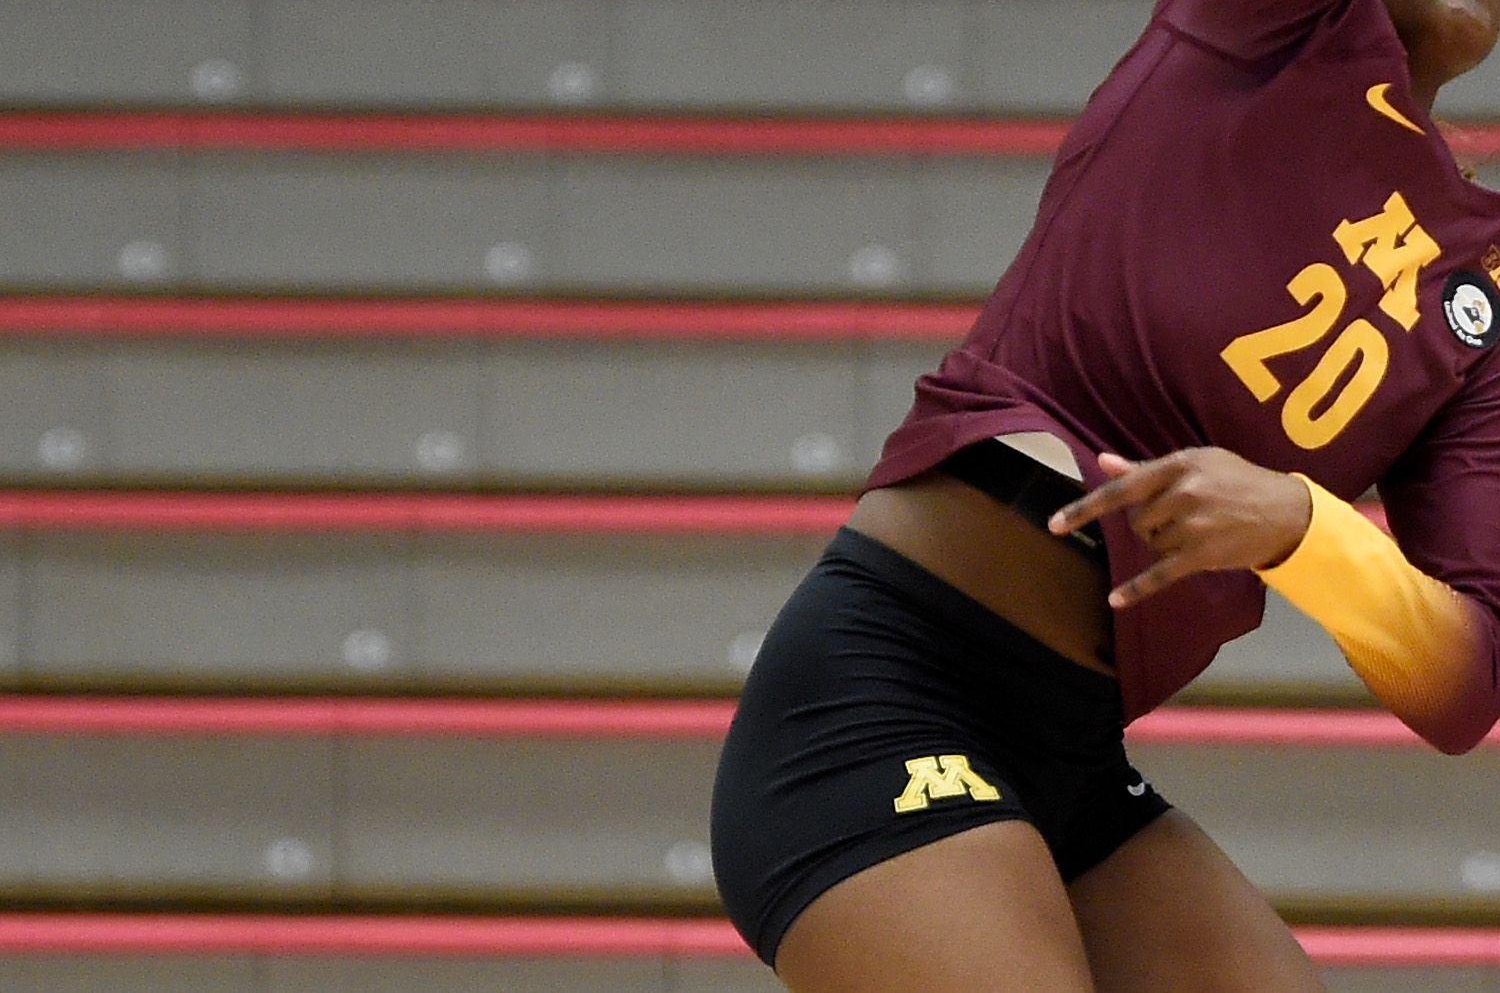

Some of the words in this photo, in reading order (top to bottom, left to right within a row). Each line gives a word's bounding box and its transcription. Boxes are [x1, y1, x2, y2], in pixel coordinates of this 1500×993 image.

[1332, 191, 1442, 332] M
[1219, 263, 1389, 449] 20
[894, 755, 1001, 813] M
